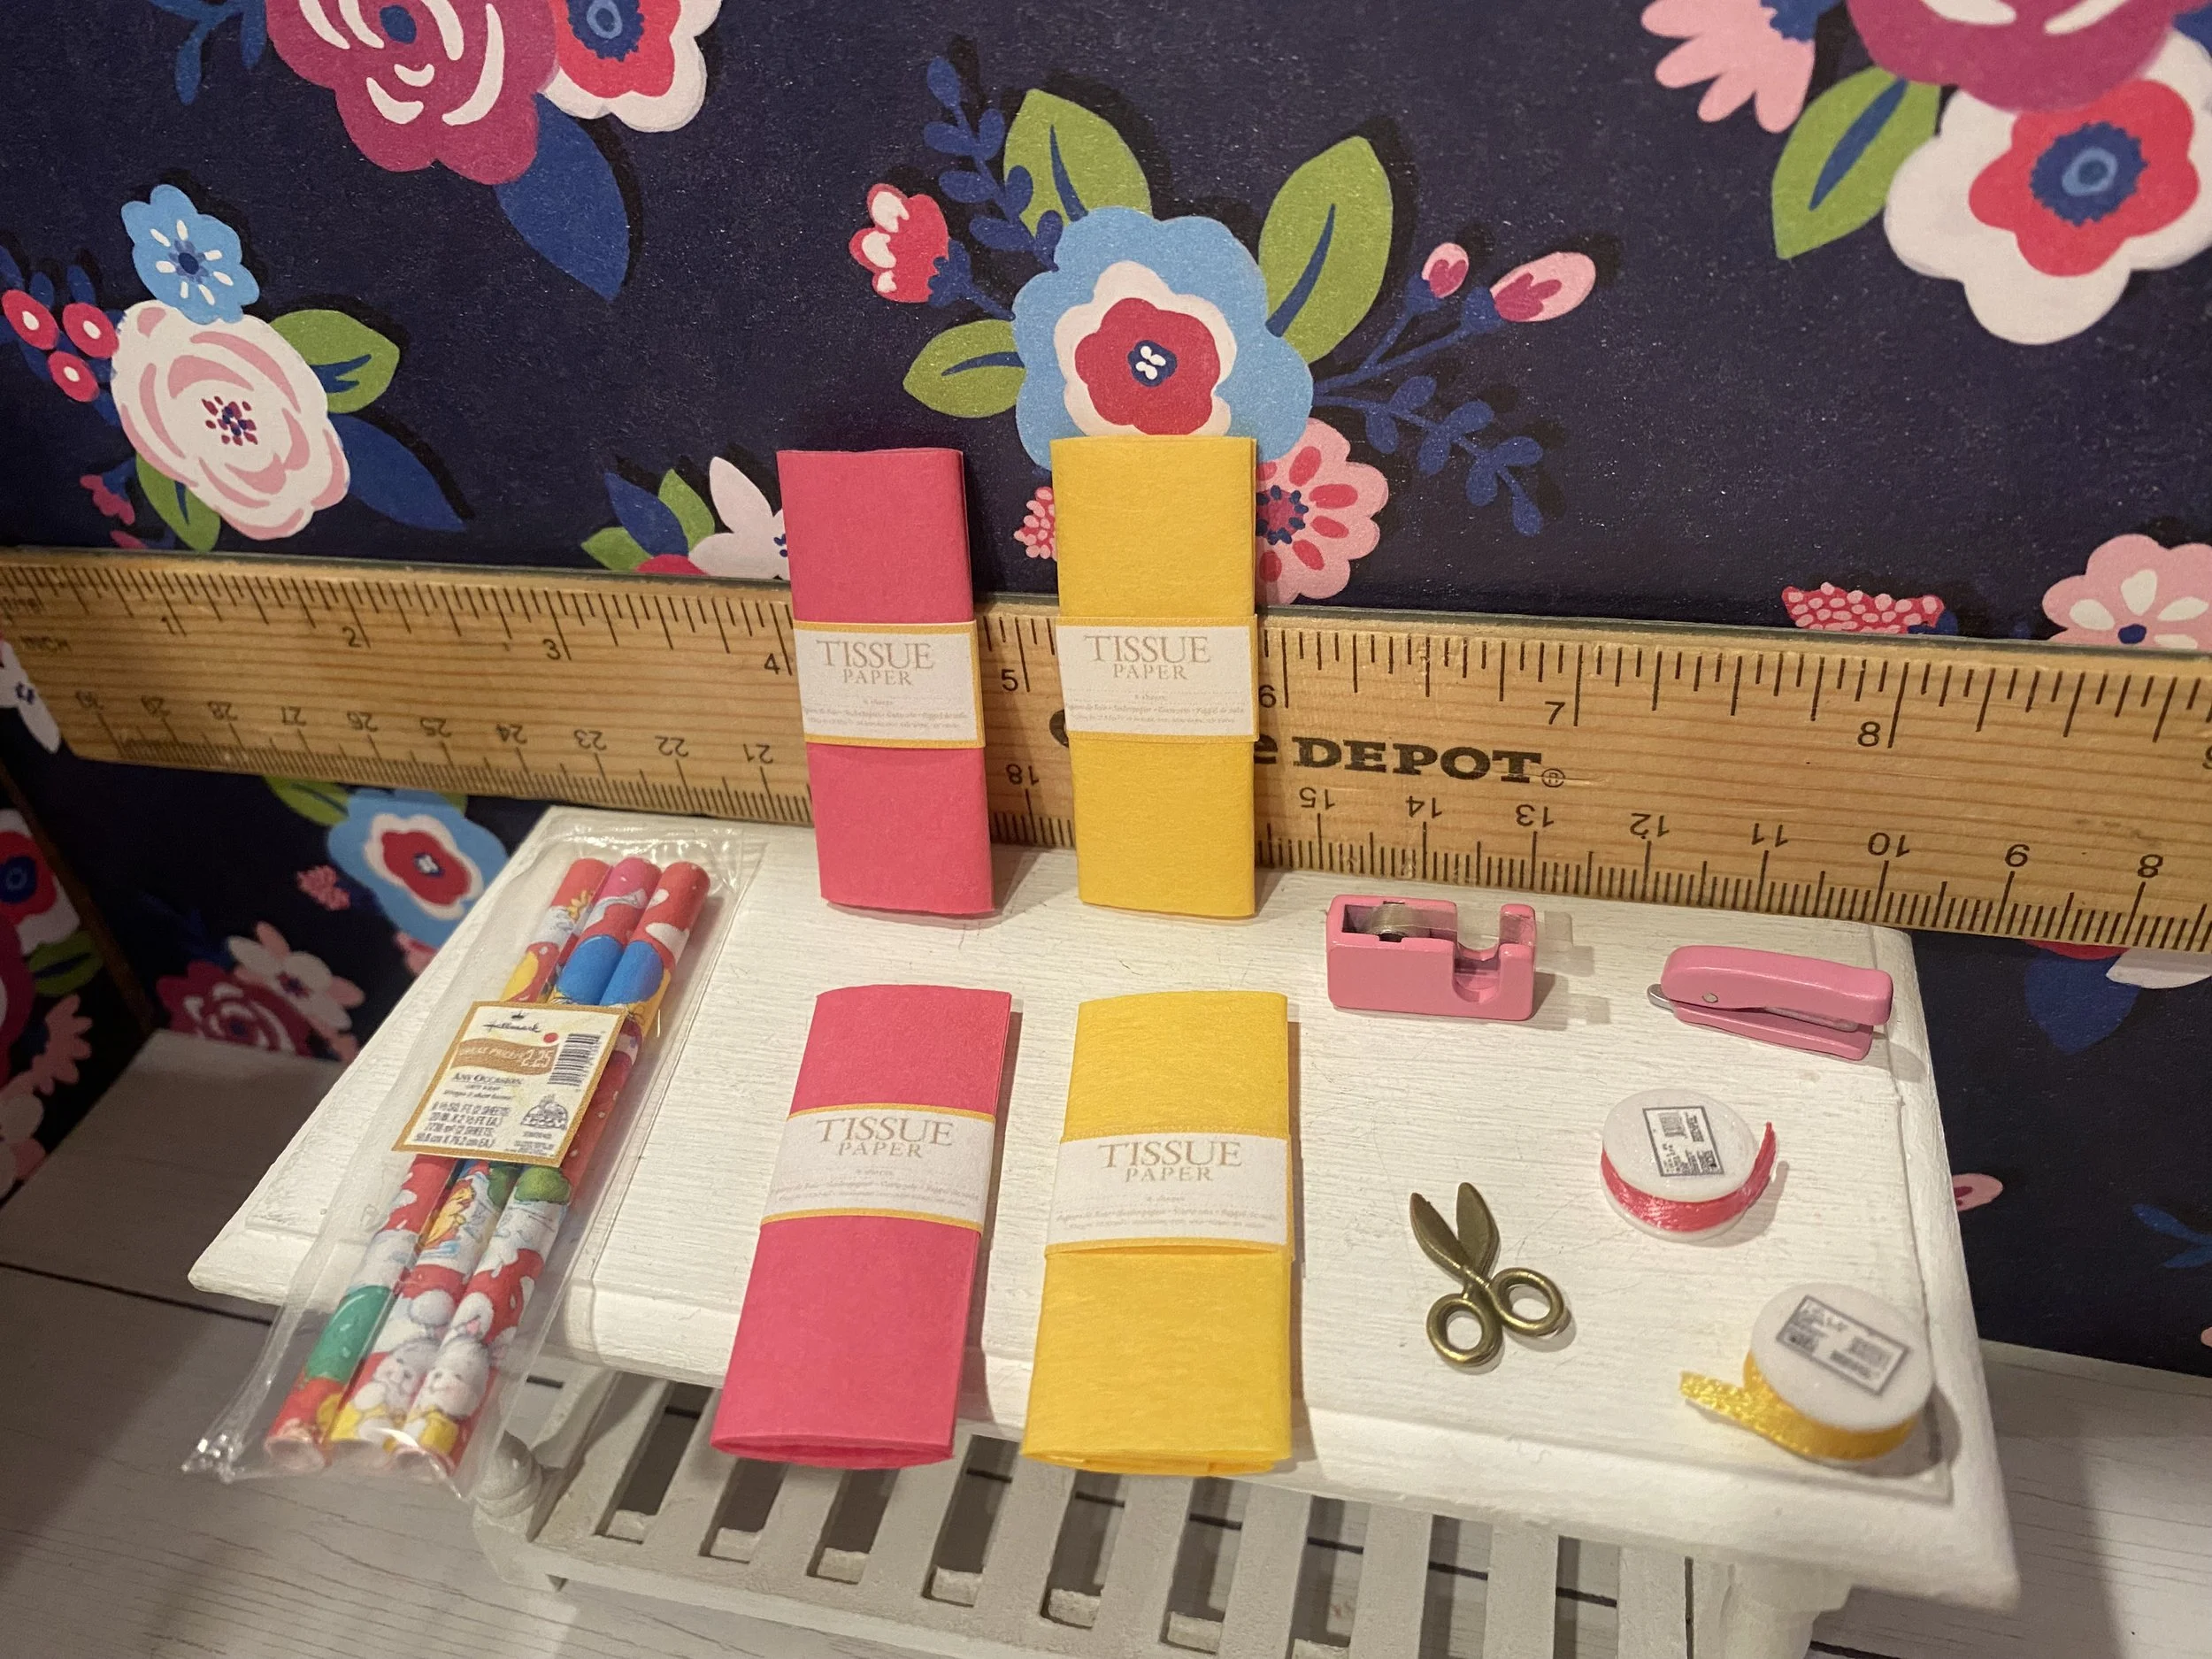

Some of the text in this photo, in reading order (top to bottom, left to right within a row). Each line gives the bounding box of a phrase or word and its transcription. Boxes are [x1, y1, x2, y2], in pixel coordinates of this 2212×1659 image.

[815, 638, 934, 671] TISSUE
[1083, 634, 1211, 664] TISSUE
[842, 668, 913, 687] PAPER
[1112, 664, 1188, 680] PAPER
[342, 626, 362, 648] 2
[542, 639, 561, 661] 3
[764, 653, 781, 675] 4
[1001, 669, 1018, 692] 5
[1258, 684, 1277, 708] 6
[1544, 700, 1566, 726] 7
[1857, 721, 1882, 748] 8
[280, 705, 308, 727] 27
[346, 710, 379, 733] 26
[419, 717, 453, 738] 25
[495, 723, 528, 745] 24
[572, 729, 608, 751] 23
[654, 735, 689, 758] 22
[743, 743, 774, 764] 21
[1291, 735, 1543, 784] DEPOT
[1005, 764, 1040, 786] 18
[1299, 787, 1335, 810] 15
[1405, 795, 1443, 818] 14
[1516, 803, 1555, 828] 13
[1630, 812, 1671, 839] 12
[1750, 822, 1789, 849] 11
[1867, 832, 1912, 858] 10
[2005, 842, 2030, 867] 9
[2138, 853, 2164, 879] 8
[815, 1117, 954, 1148] TISSUE
[838, 1140, 924, 1159] PAPER
[1098, 1140, 1243, 1168] TISSUE
[1125, 1164, 1214, 1183] PAPER
